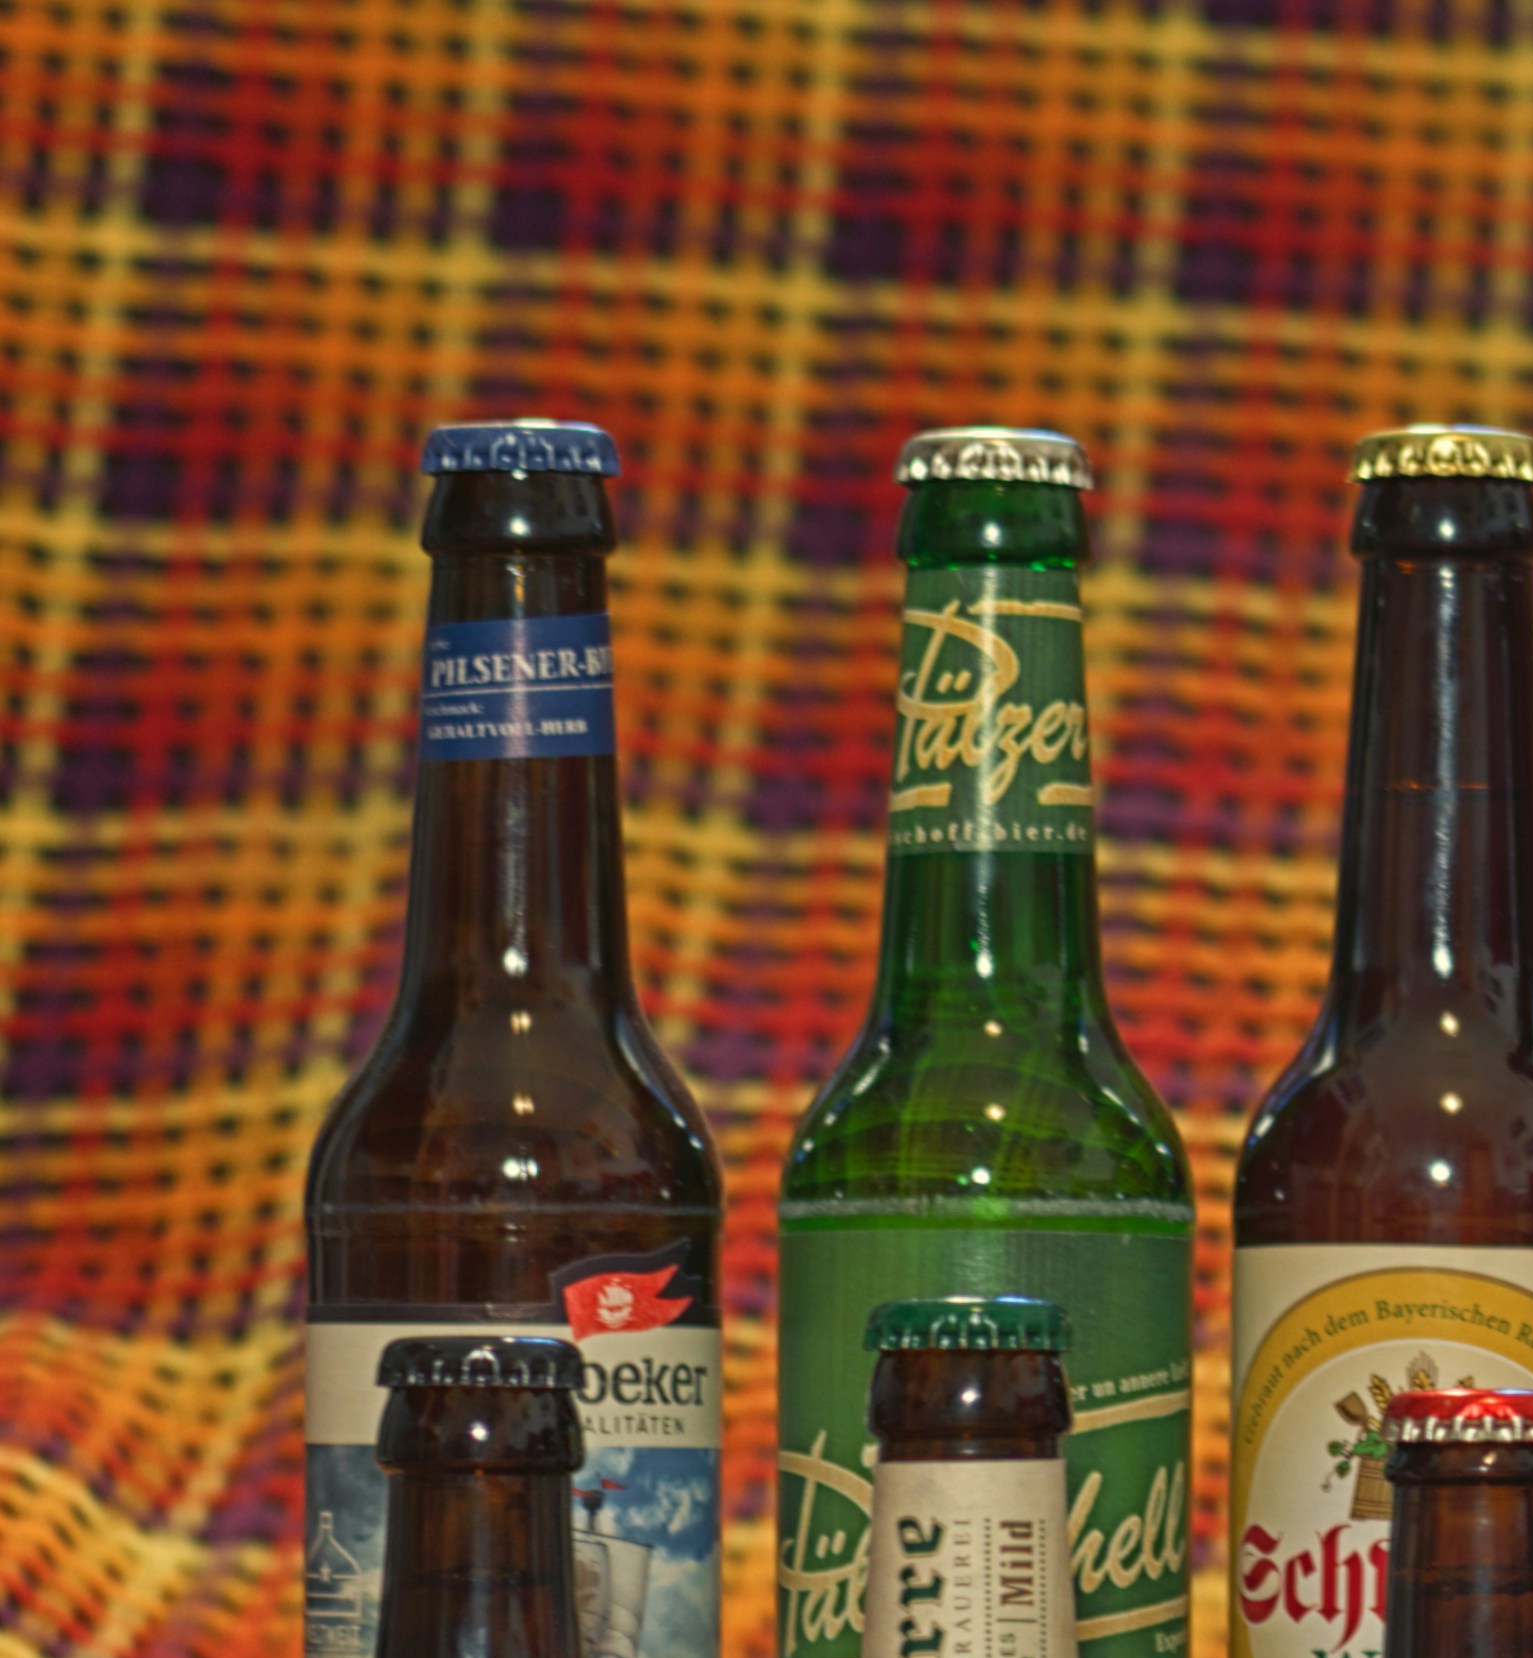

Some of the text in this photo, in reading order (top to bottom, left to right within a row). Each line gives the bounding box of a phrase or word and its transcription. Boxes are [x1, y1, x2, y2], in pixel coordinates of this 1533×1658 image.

[1281, 1326, 1323, 1377] nach
[1325, 1305, 1370, 1335] dem
[1374, 1299, 1513, 1337] Bayerischen
[999, 1518, 1035, 1608] Mild
